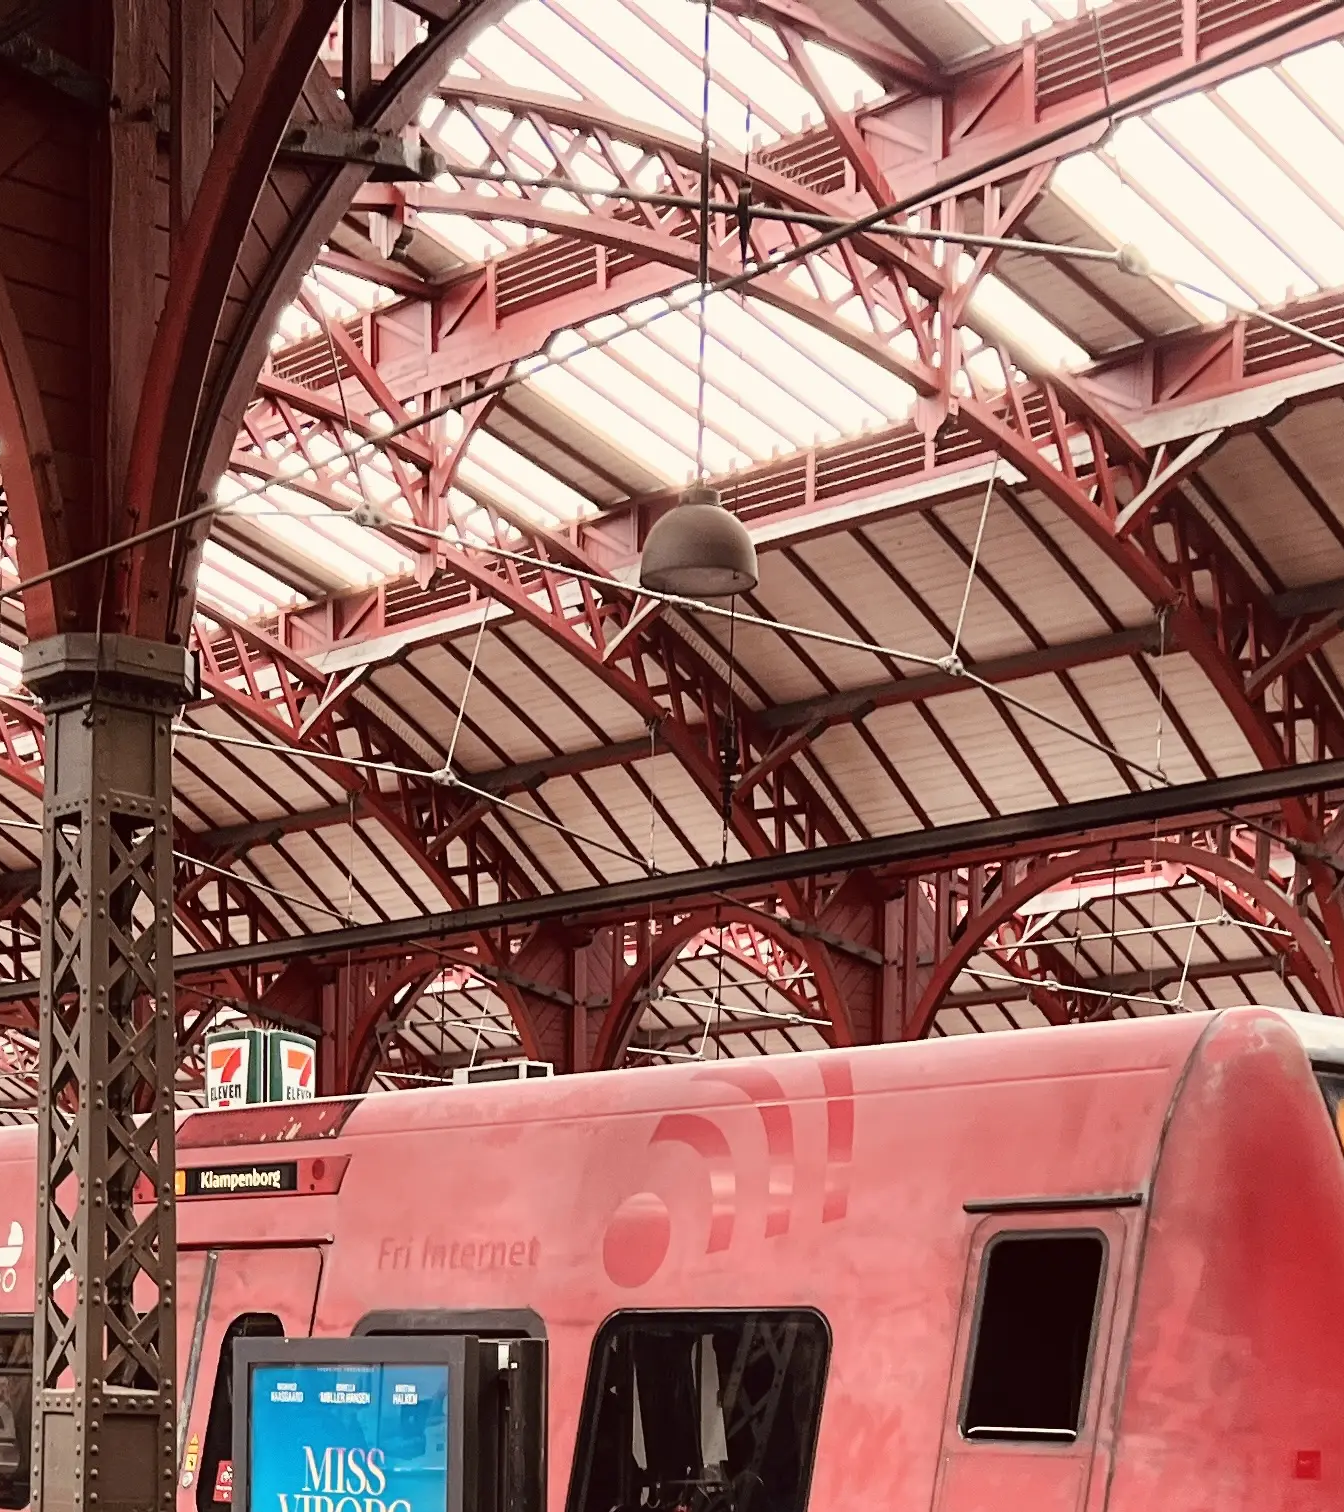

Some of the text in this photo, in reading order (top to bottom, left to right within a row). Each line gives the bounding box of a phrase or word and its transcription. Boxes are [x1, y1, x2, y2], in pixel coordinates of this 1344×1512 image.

[211, 1047, 242, 1106] 7
[287, 1049, 312, 1087] 7
[200, 1168, 281, 1192] Klampenborg
[378, 1235, 541, 1270] Fri Internet
[302, 1446, 386, 1496] MISS
